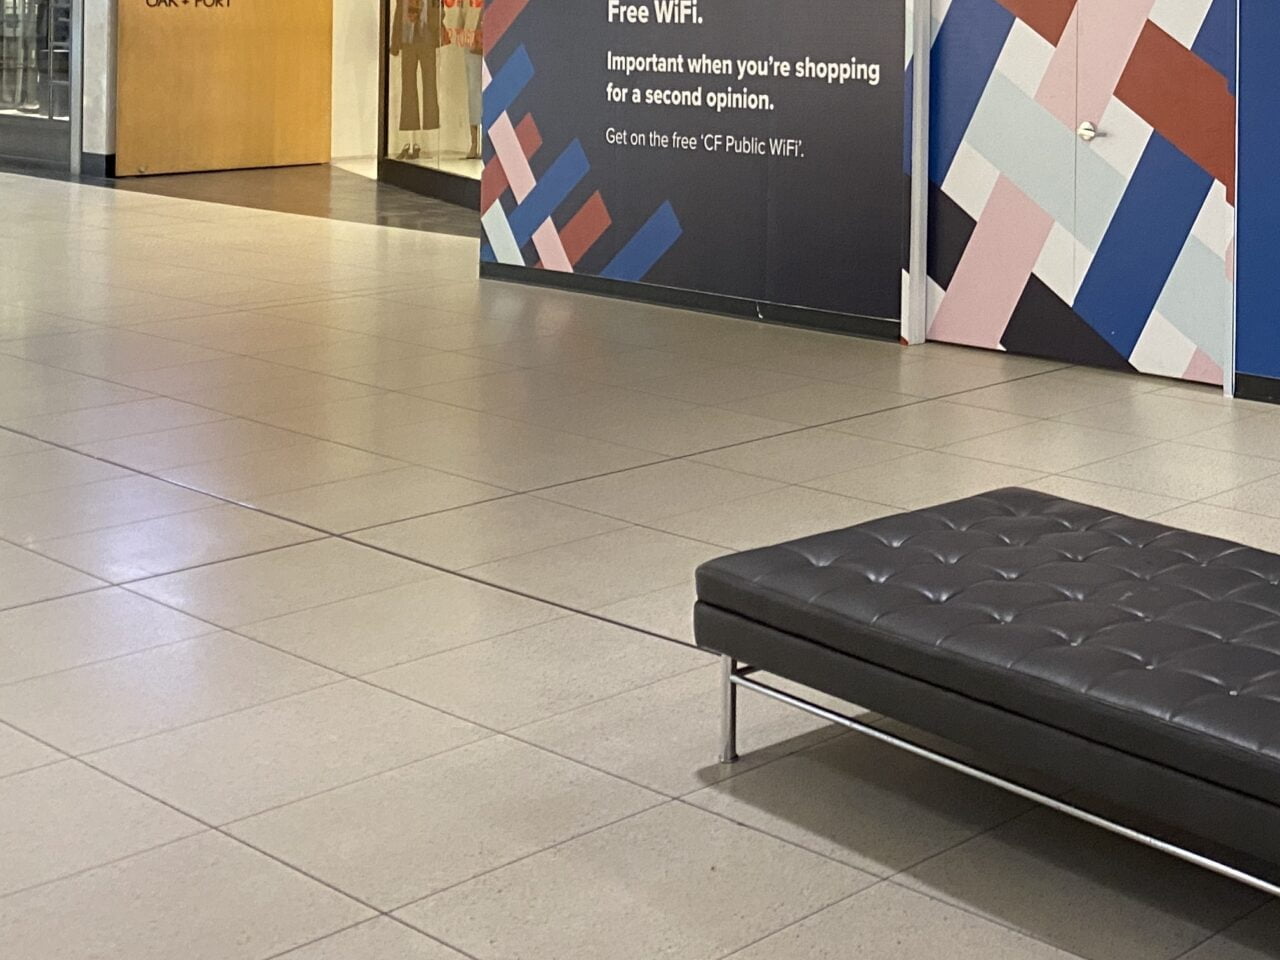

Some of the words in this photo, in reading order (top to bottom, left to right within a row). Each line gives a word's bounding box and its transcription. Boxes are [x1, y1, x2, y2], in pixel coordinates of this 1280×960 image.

[607, 0, 650, 24] Free
[607, 50, 684, 76] Important
[687, 54, 732, 74] when
[736, 55, 791, 80] you're
[795, 56, 881, 85] shopping
[606, 82, 628, 102] for
[631, 88, 641, 103] a
[645, 86, 702, 106] second
[706, 86, 775, 112] opinion.
[605, 127, 628, 145] Get
[630, 132, 646, 146] on
[649, 130, 669, 148] the
[672, 131, 697, 150] free
[701, 133, 723, 151] 'CF
[725, 135, 766, 155] Public
[769, 138, 805, 157] WiFi'.
